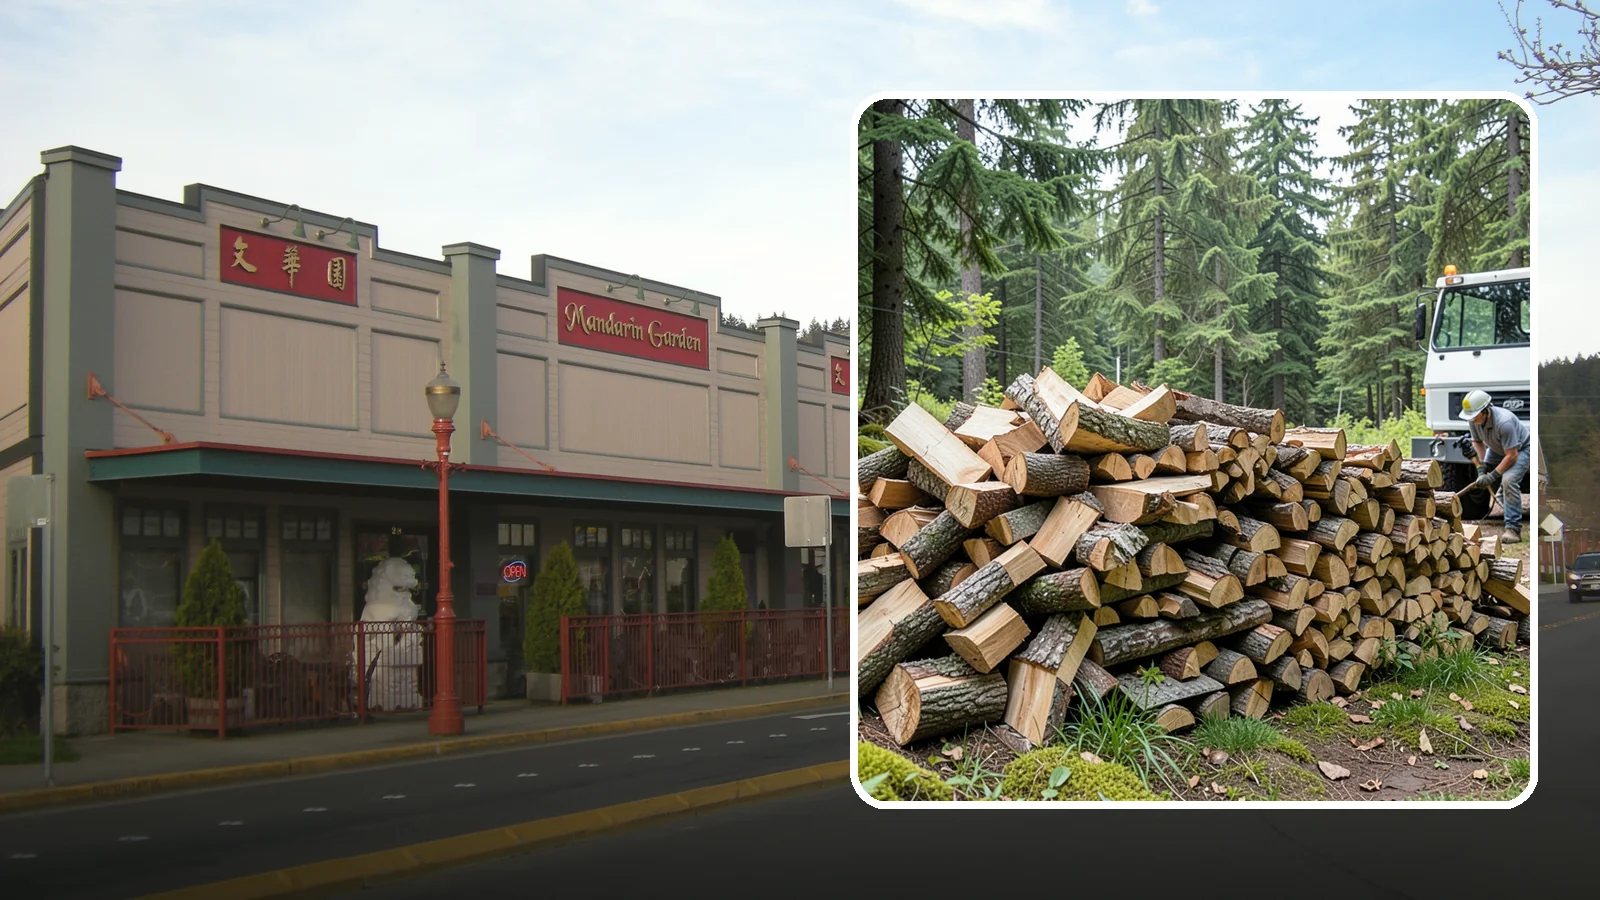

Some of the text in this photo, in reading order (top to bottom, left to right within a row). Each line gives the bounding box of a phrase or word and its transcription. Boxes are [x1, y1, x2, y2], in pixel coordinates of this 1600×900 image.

[230, 235, 346, 291] 文華園
[564, 302, 702, 352] Mandarin Garden
[503, 565, 527, 578] OPEN
